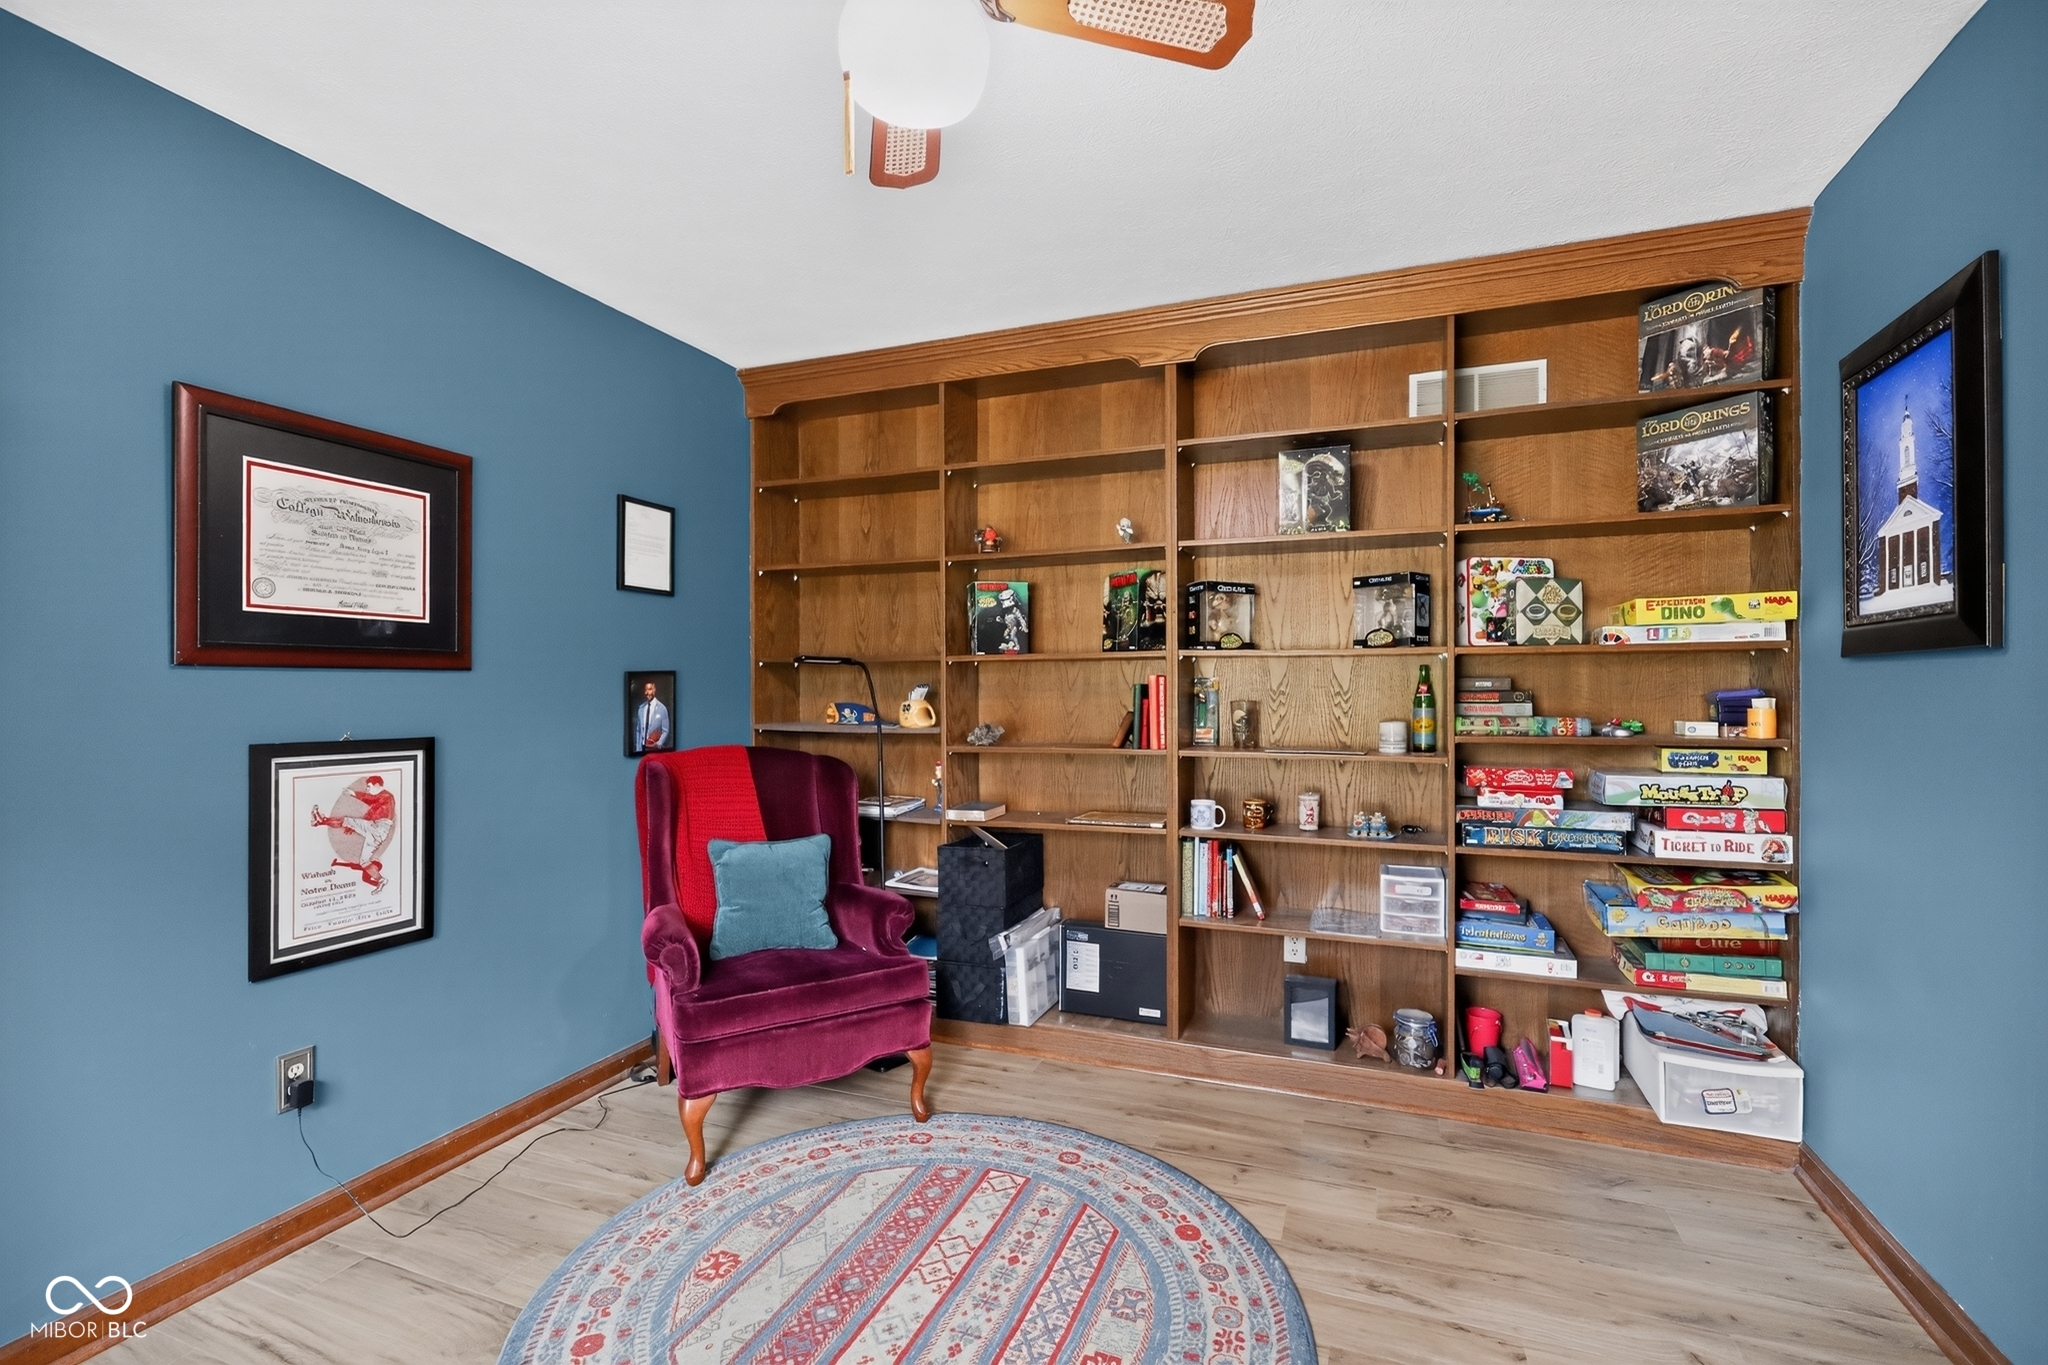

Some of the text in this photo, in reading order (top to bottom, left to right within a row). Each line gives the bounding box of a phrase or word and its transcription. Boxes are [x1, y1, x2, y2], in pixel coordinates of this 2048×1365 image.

[1643, 302, 1683, 322] LORD
[1641, 420, 1680, 438] LORD
[1701, 402, 1751, 423] RINGS
[1764, 596, 1793, 606] HABA
[1661, 605, 1706, 620] DINO
[1737, 755, 1761, 764] HABA
[1483, 826, 1545, 848] RISK
[1661, 837, 1707, 853] TICKET
[1724, 838, 1755, 854] RIDE
[301, 881, 357, 896] Notre Dame
[1765, 894, 1798, 905] HABA
[1695, 938, 1742, 949] Clue
